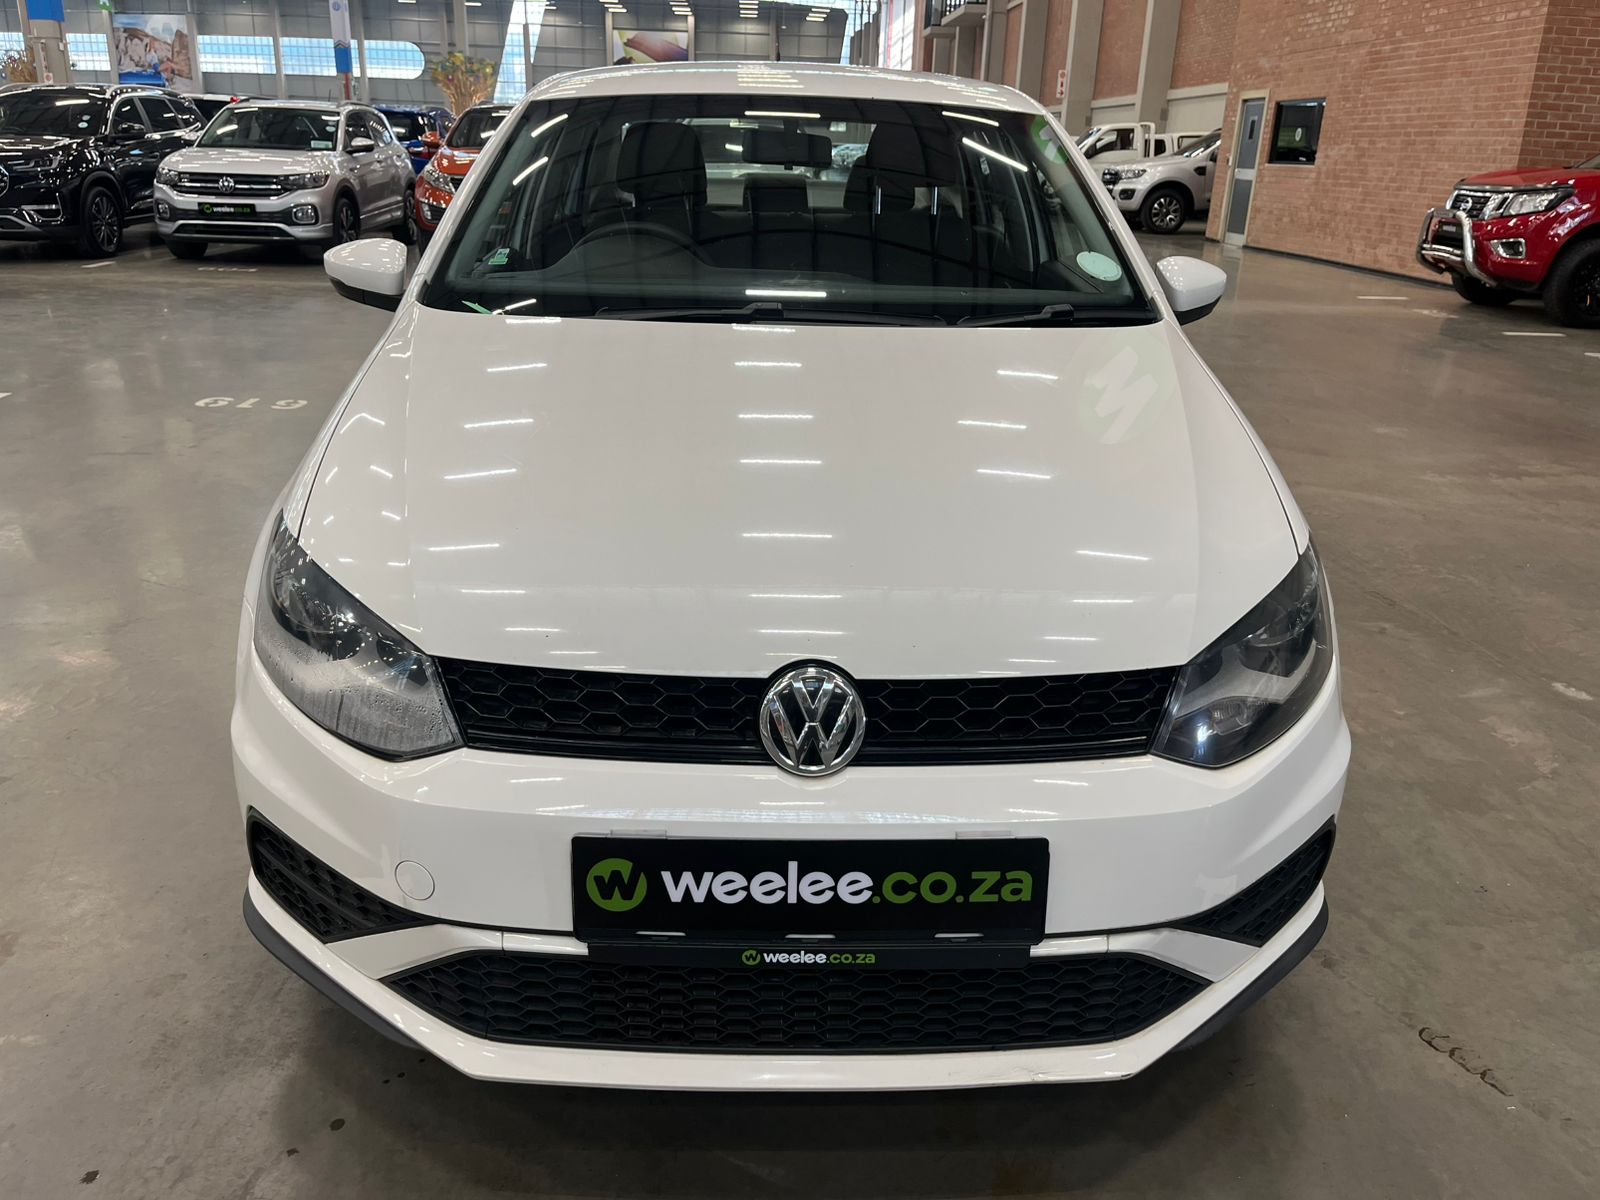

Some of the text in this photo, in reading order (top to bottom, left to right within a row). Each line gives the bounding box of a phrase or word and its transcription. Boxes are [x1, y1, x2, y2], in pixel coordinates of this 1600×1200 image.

[194, 396, 308, 410] 619
[661, 861, 1032, 904] weelee.co.za
[763, 950, 875, 964] weelee.co.za
